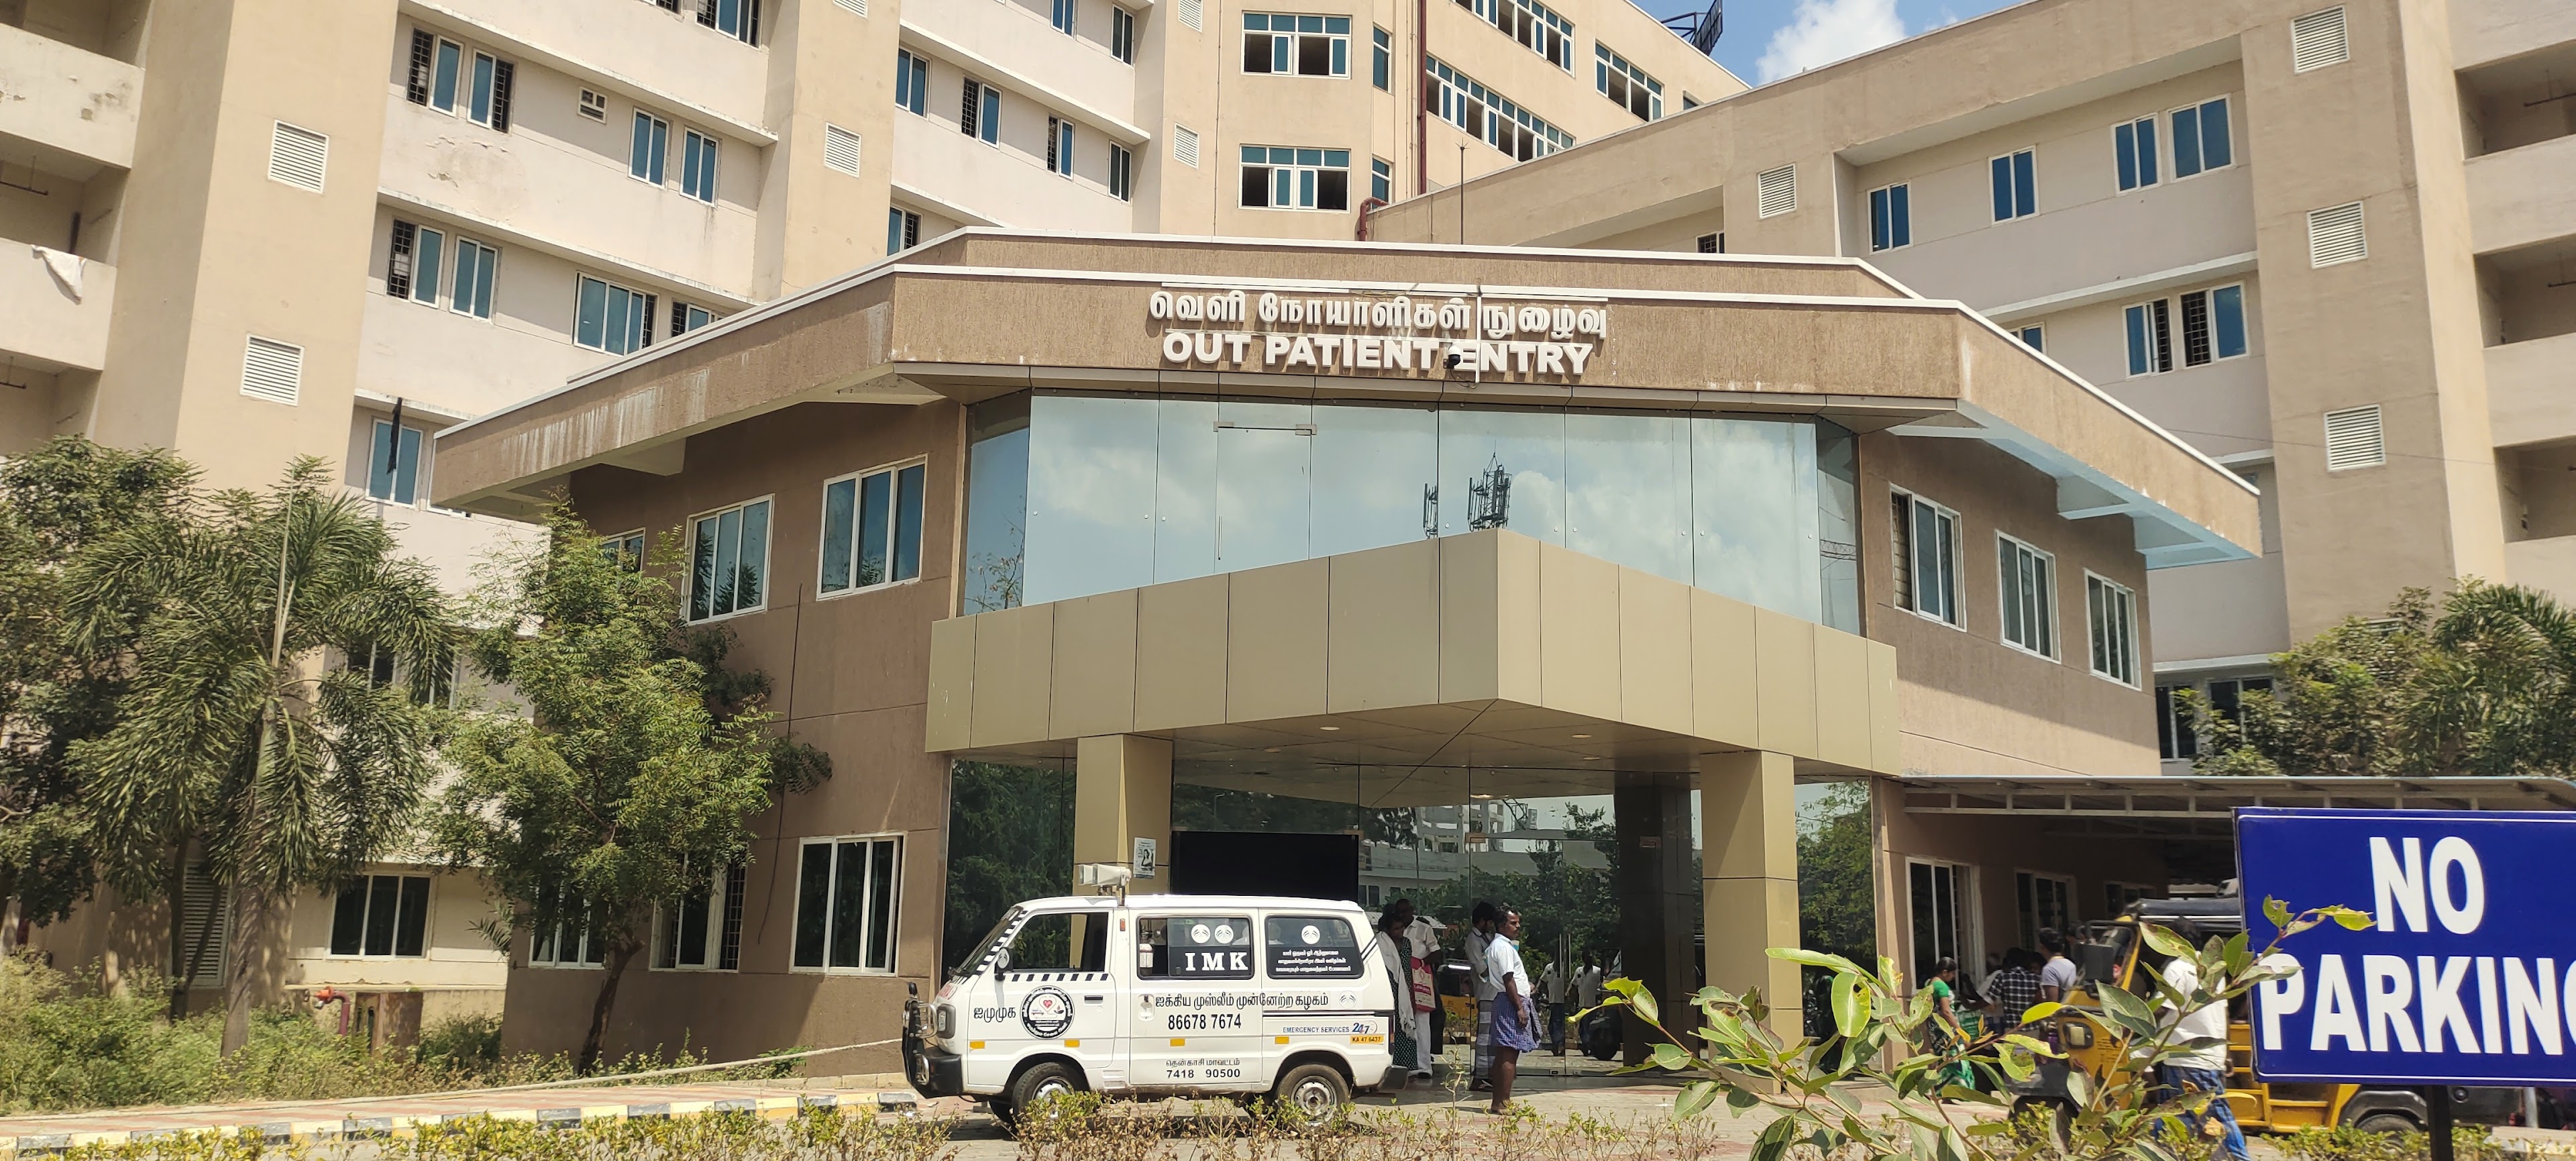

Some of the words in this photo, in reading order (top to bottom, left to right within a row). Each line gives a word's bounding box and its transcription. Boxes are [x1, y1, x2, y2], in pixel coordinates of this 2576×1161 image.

[1150, 290, 1246, 323] வெளி
[1258, 293, 1471, 330] நோயாளிகள்
[1483, 305, 1607, 340] நுழைவு
[1163, 332, 1252, 364] OUT
[1265, 335, 1440, 370] PATIENT
[1454, 340, 1593, 376] ENTRY
[2369, 836, 2485, 935] NO
[1155, 993, 1191, 1007] ஐக்கிய
[1194, 992, 1234, 1010] முஸ்லீம்
[1236, 993, 1293, 1010] முன்னேற்ற
[1295, 993, 1329, 1010] கழகம்
[2257, 953, 2576, 1056] PARKIN
[1168, 1014, 1206, 1029] 86678
[1211, 1013, 1241, 1029] 7674
[1166, 1058, 1204, 1068] தென்காசி
[1206, 1058, 1240, 1066] மாவட்டம்
[1167, 1070, 1194, 1078] 7418
[1205, 1069, 1240, 1078] 90500
